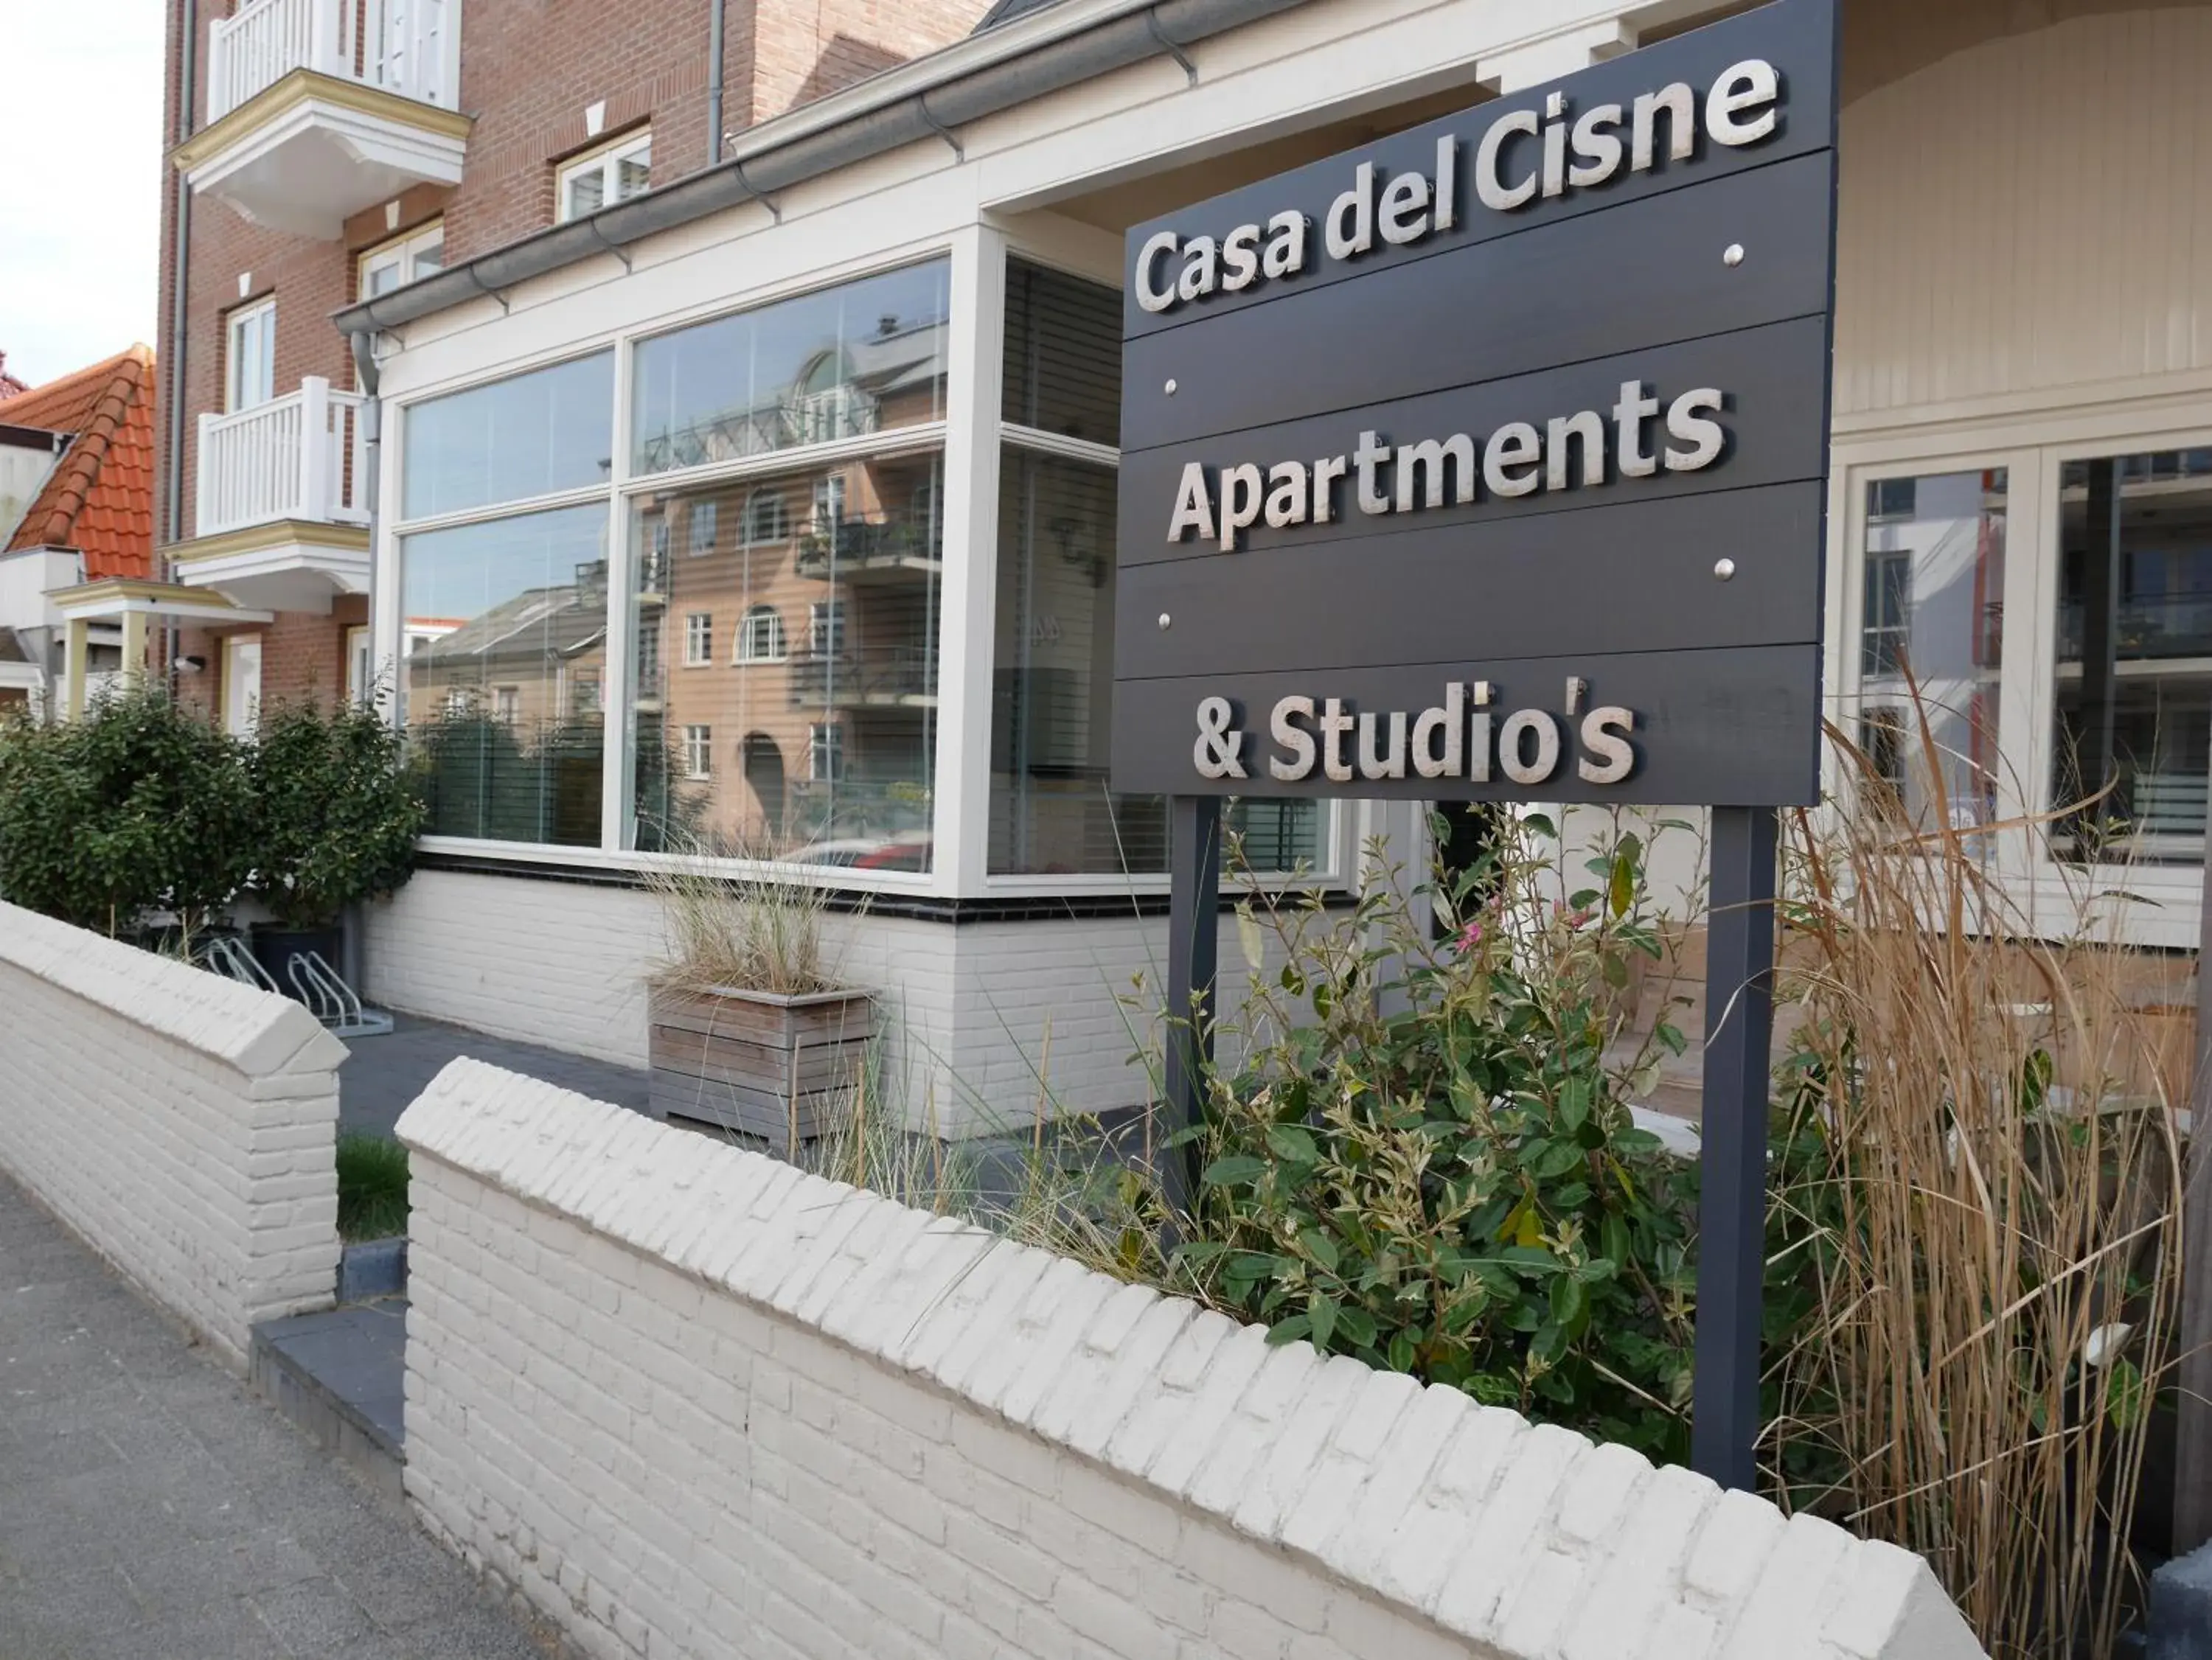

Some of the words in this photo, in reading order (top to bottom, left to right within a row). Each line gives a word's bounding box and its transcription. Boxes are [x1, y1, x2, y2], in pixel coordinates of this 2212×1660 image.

[1134, 209, 1305, 313] Casa
[1324, 133, 1455, 261] del
[1475, 58, 1780, 211] Cisne
[1166, 380, 1723, 551] Apartments
[1193, 696, 1249, 780] &
[1269, 676, 1634, 784] Studio's
